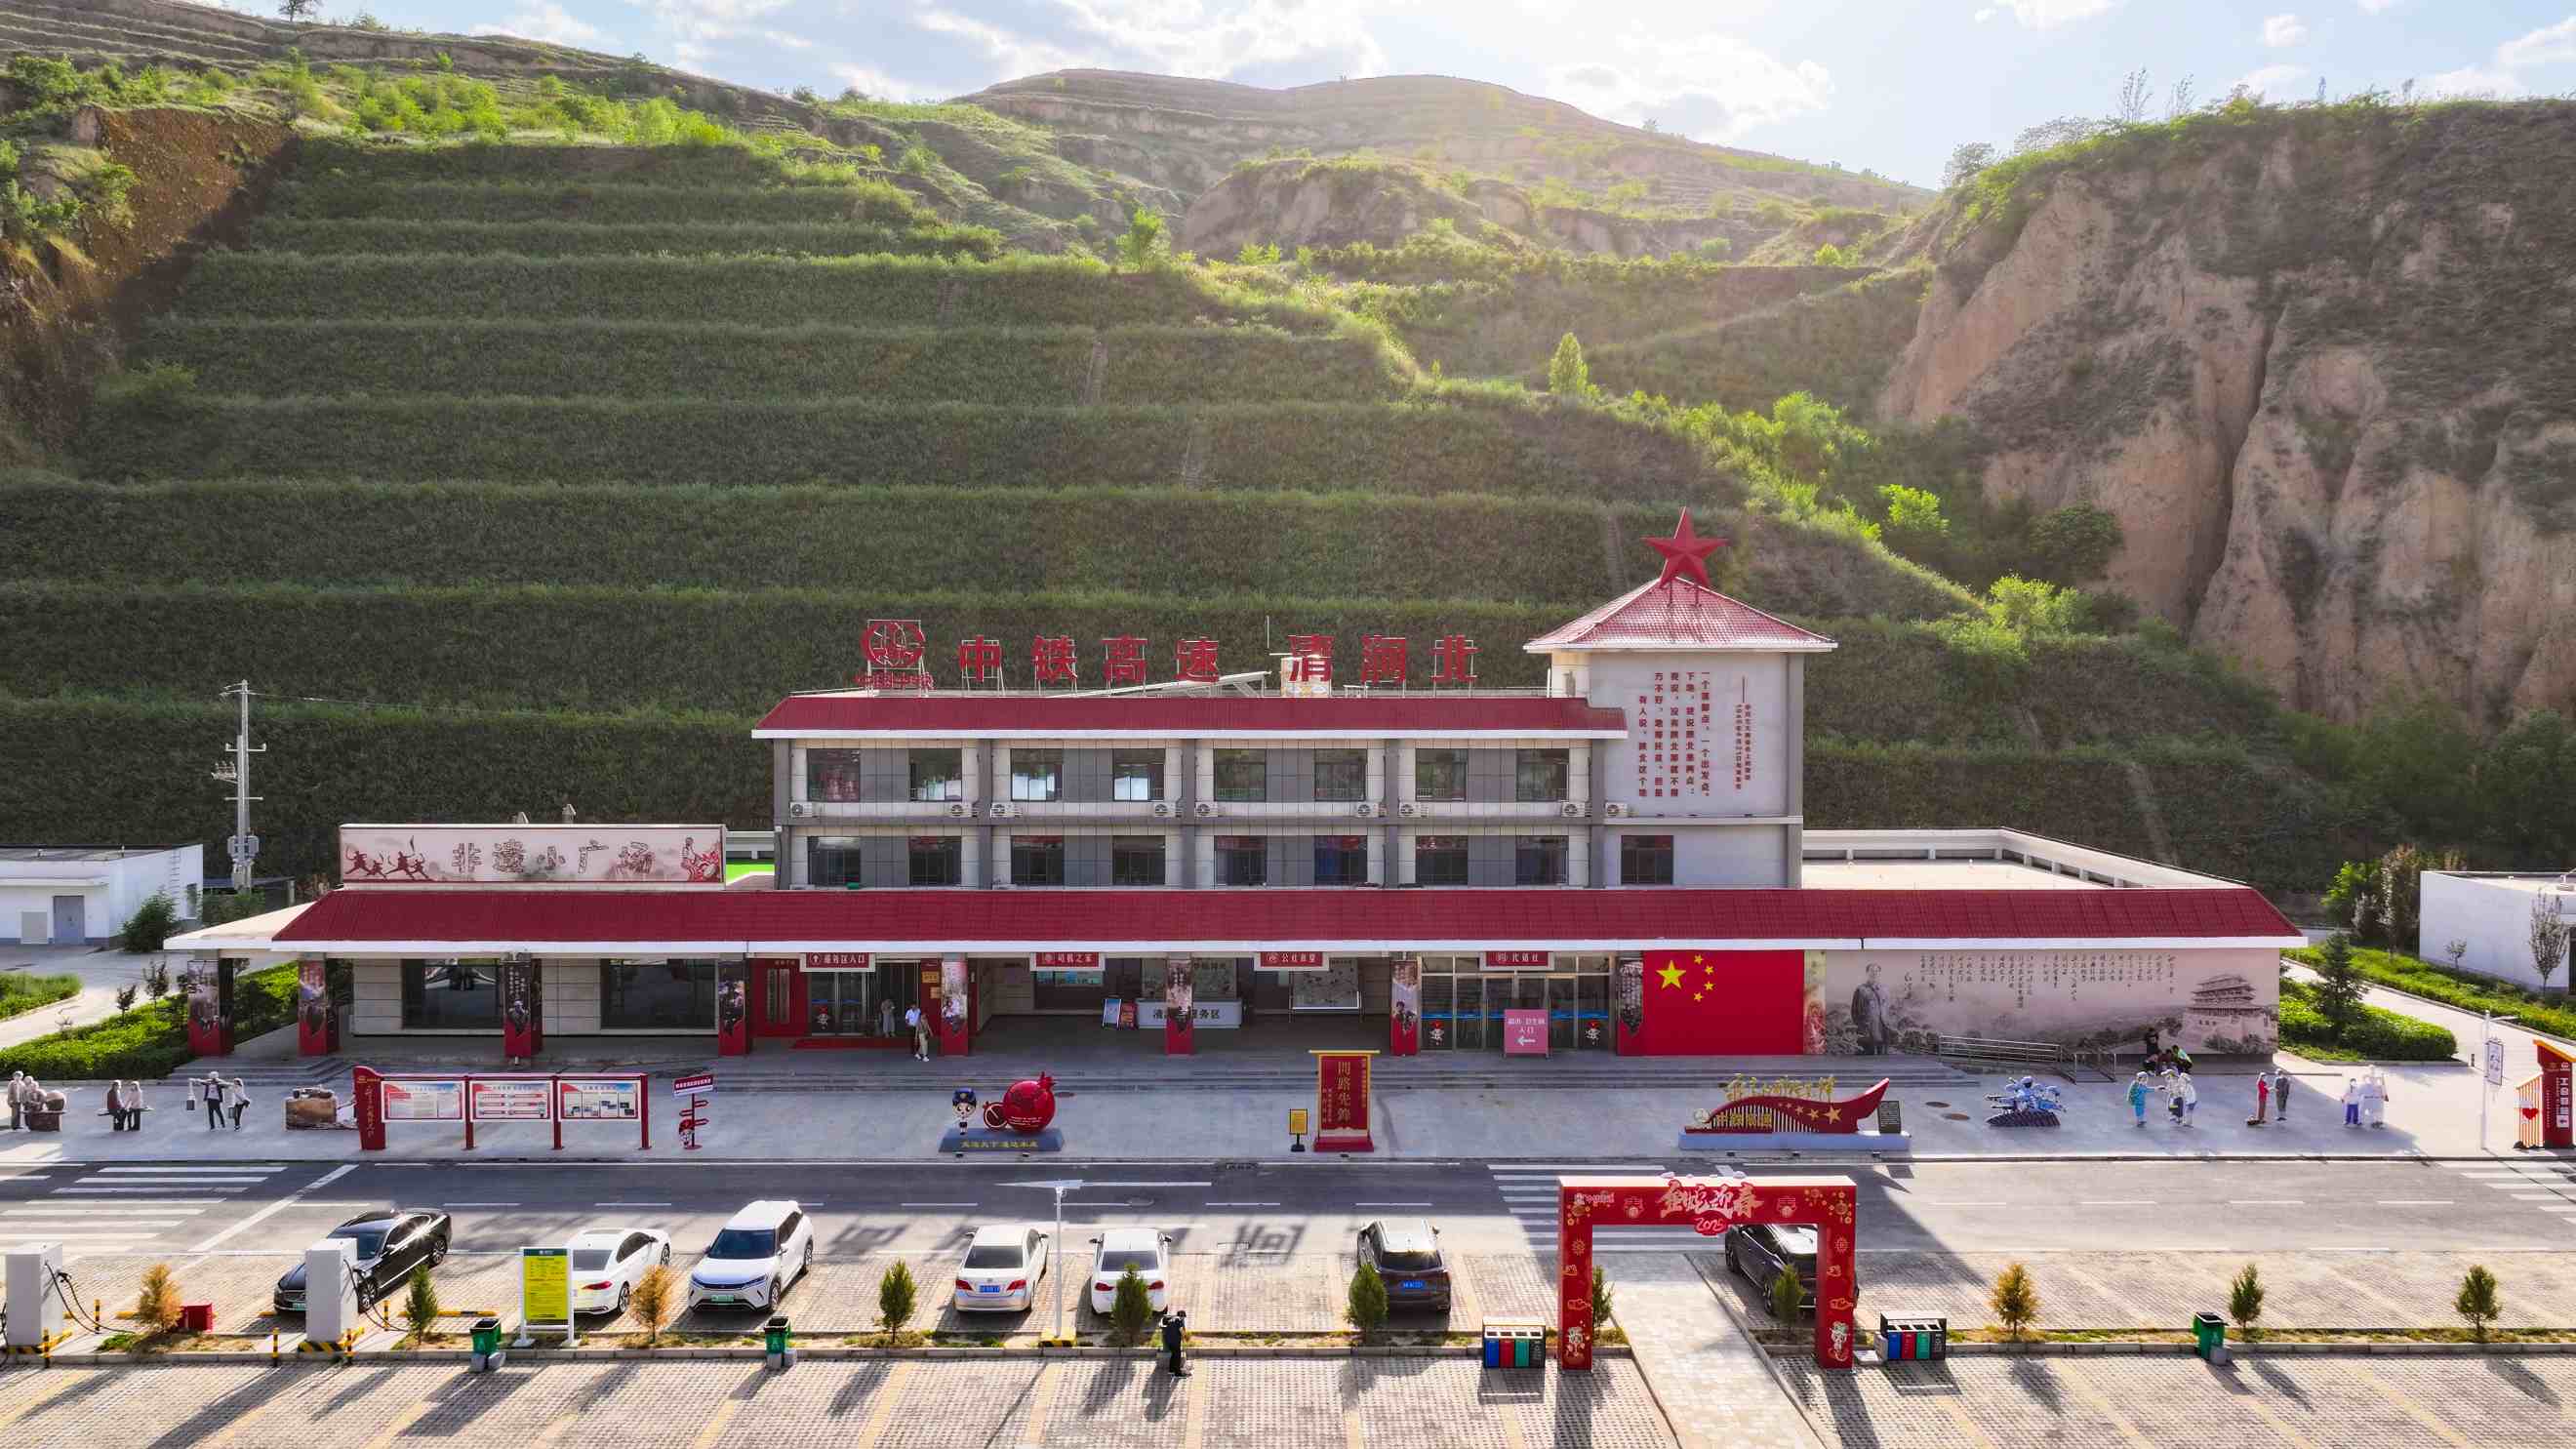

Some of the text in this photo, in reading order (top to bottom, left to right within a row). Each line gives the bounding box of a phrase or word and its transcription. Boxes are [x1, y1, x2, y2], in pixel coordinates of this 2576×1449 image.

[958, 633, 1483, 685] 中铁高速 清涧北
[1058, 953, 1093, 963] 司机之家
[1656, 1180, 1764, 1220] 金蛇迎春
